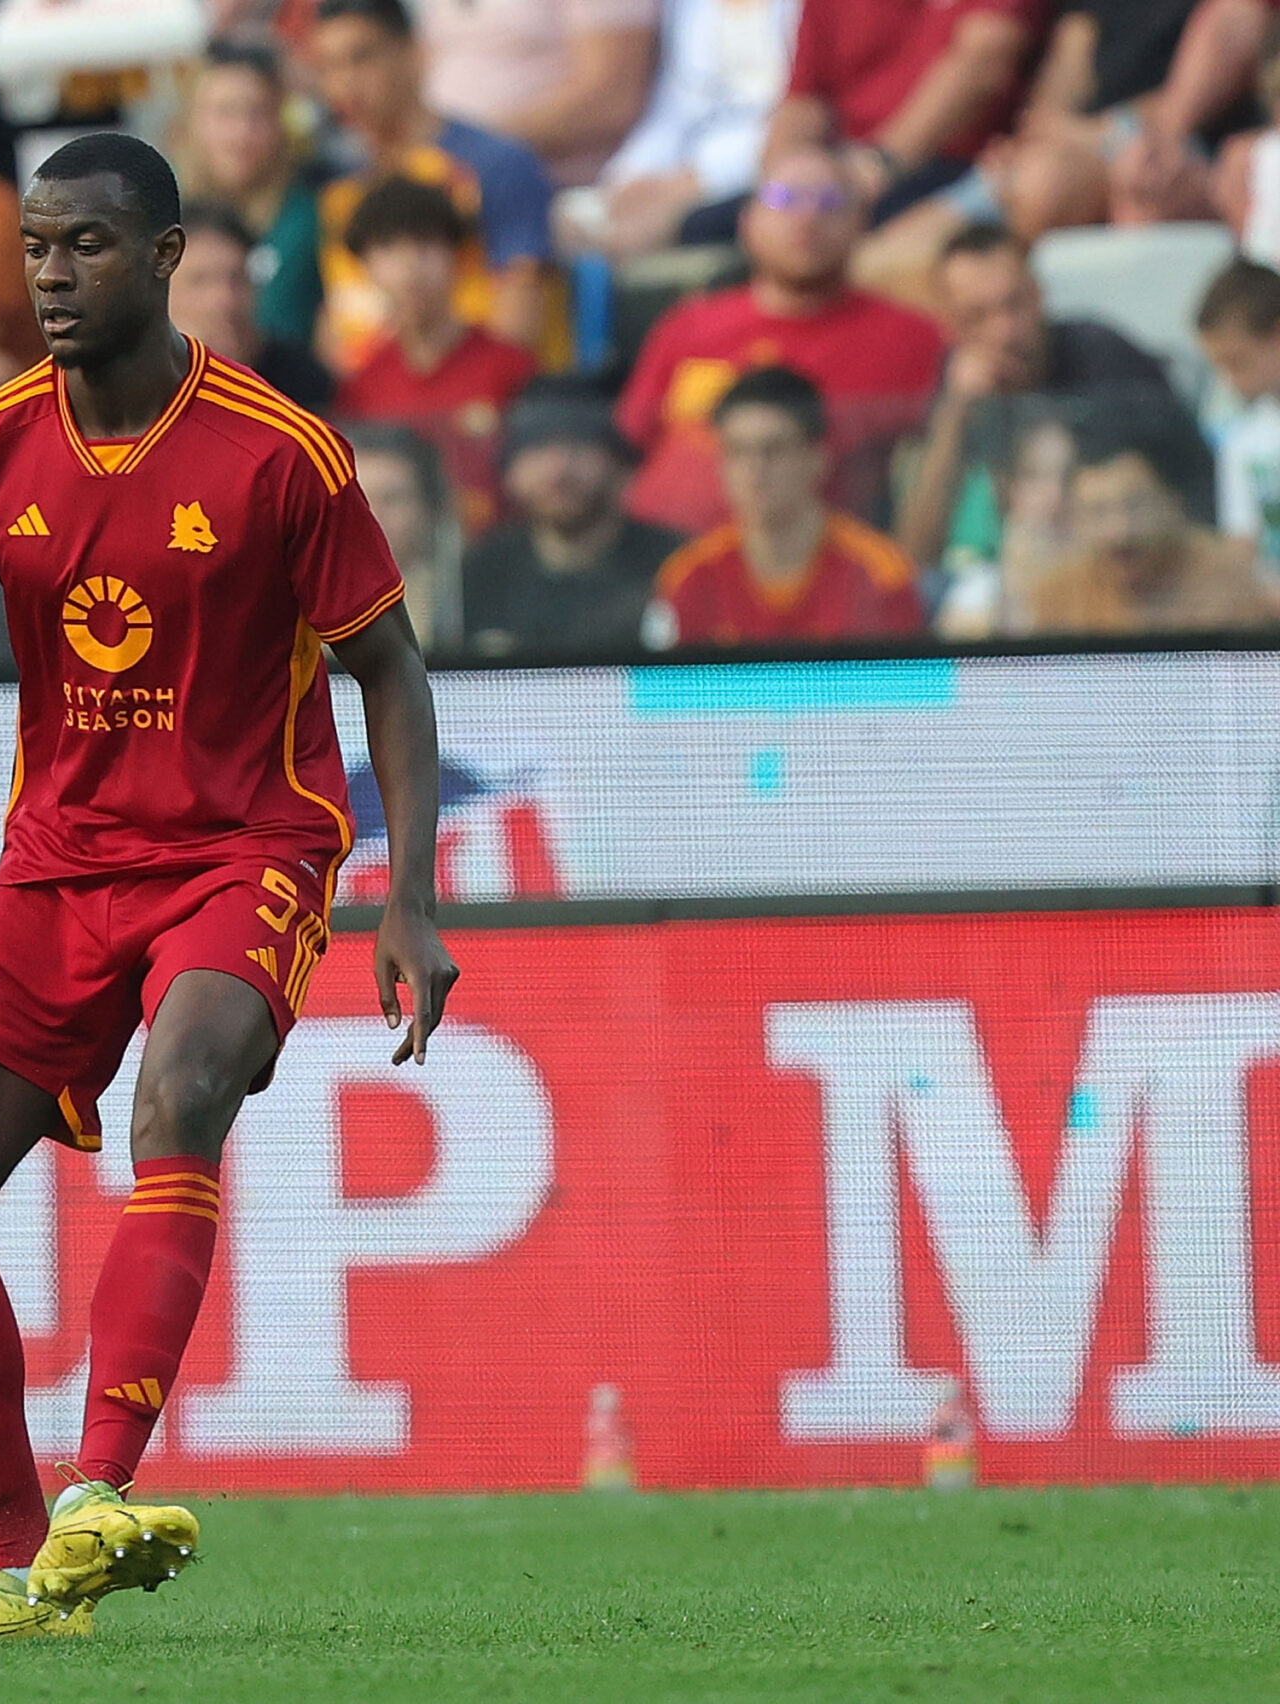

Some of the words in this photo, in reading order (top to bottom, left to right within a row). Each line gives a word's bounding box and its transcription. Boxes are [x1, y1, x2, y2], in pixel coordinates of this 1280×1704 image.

[63, 682, 174, 708] RIYADH
[65, 708, 174, 732] SEASON
[256, 867, 299, 934] 5
